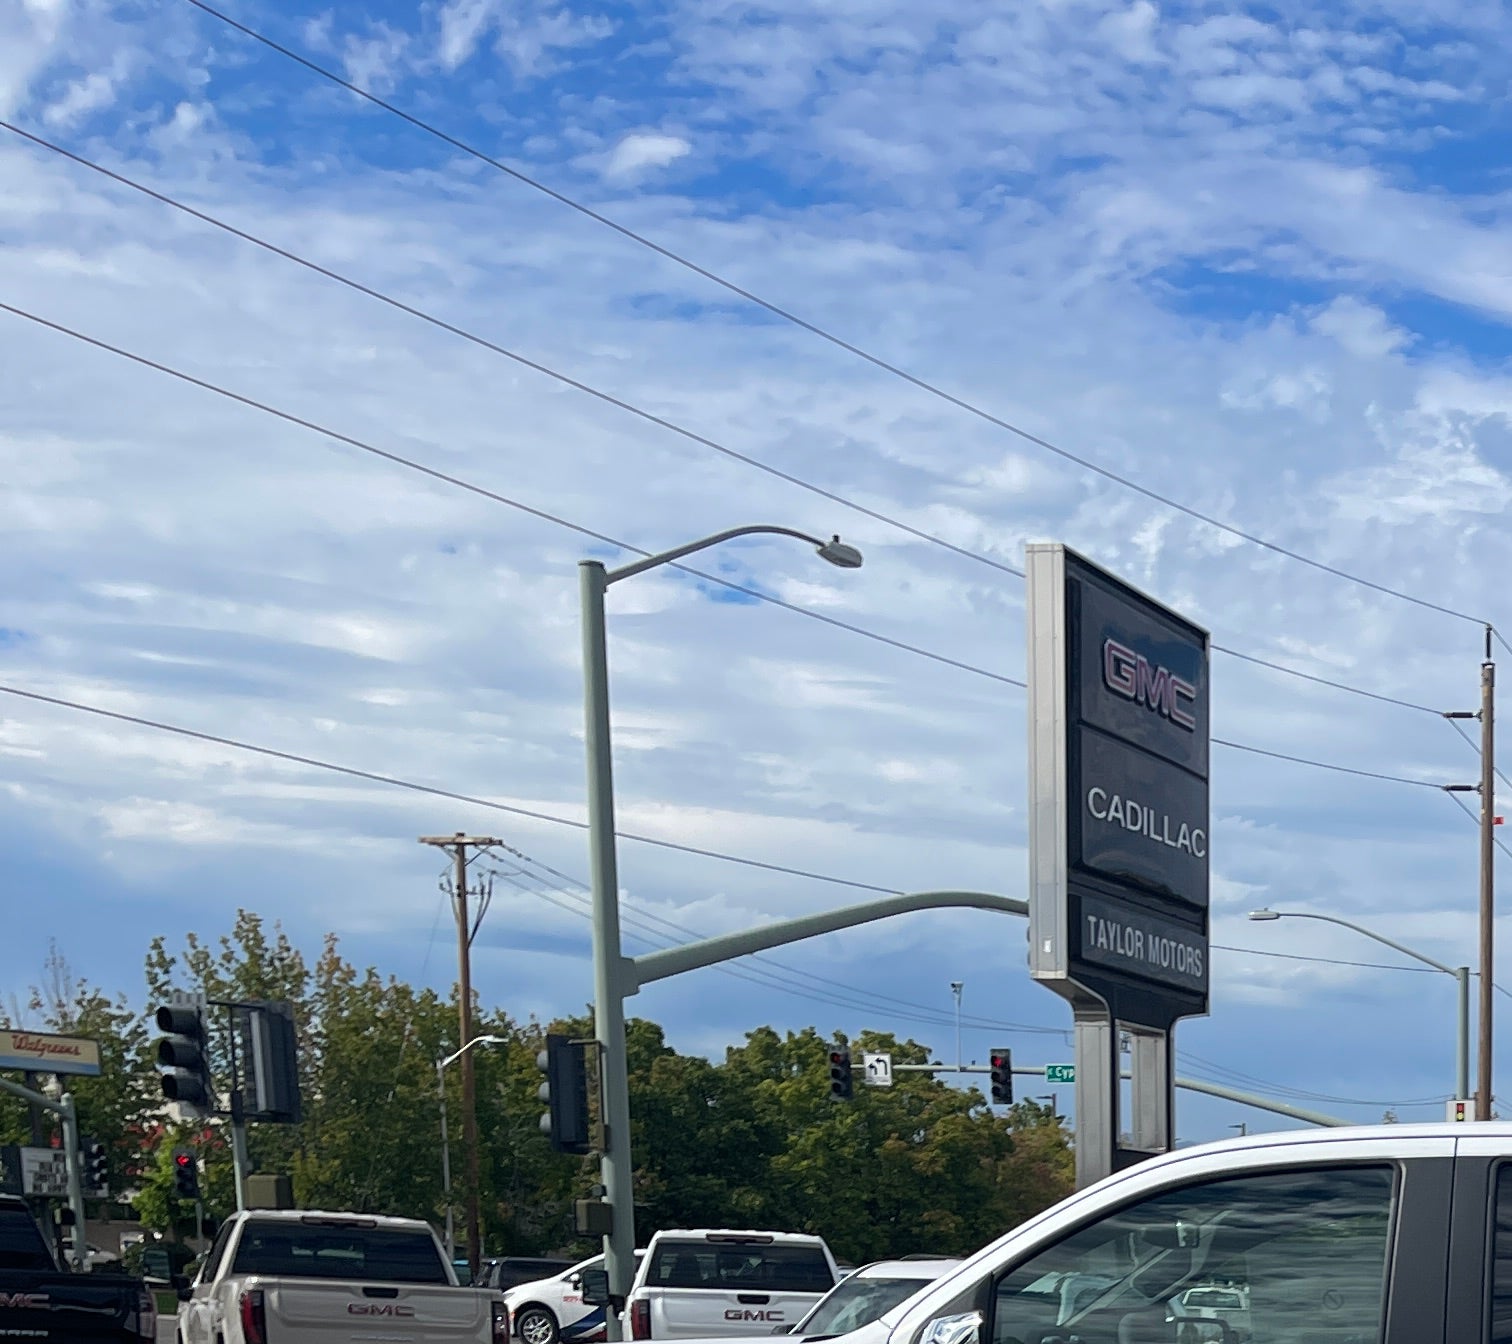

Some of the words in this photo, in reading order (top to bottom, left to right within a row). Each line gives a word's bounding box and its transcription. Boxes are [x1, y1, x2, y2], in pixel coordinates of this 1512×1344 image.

[1104, 639, 1196, 730] GMC
[1088, 787, 1206, 858] CADILLAC
[1088, 915, 1144, 960] TAYLOR
[1148, 934, 1202, 977] MOTORS
[11, 1035, 82, 1057] Walgreens
[0, 1292, 50, 1309] MC
[347, 1303, 415, 1317] GMC
[724, 1309, 785, 1322] GMC
